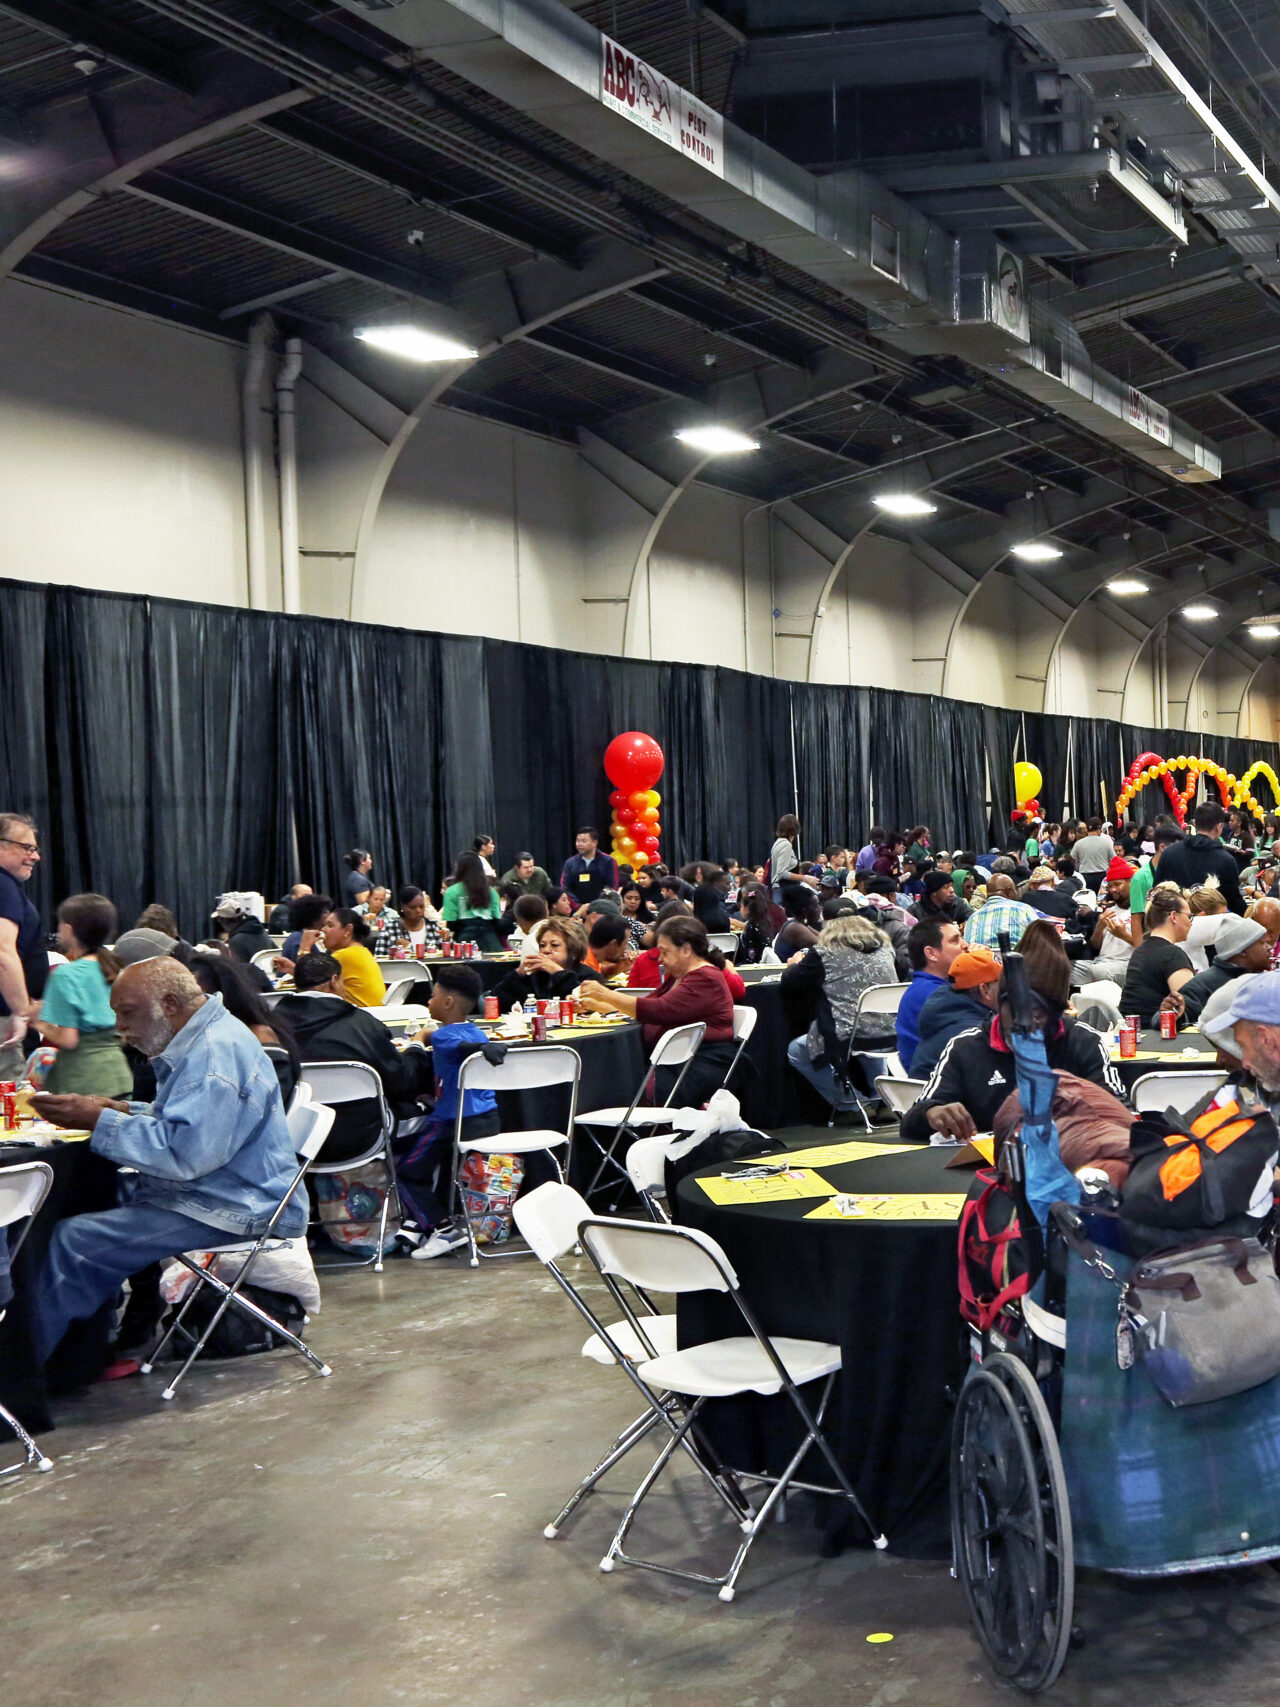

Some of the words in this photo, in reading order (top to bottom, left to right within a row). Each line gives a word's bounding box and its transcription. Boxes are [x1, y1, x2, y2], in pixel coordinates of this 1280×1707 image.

[604, 40, 636, 108] ABC
[688, 111, 708, 137] PEST
[681, 129, 716, 165] CONTROL
